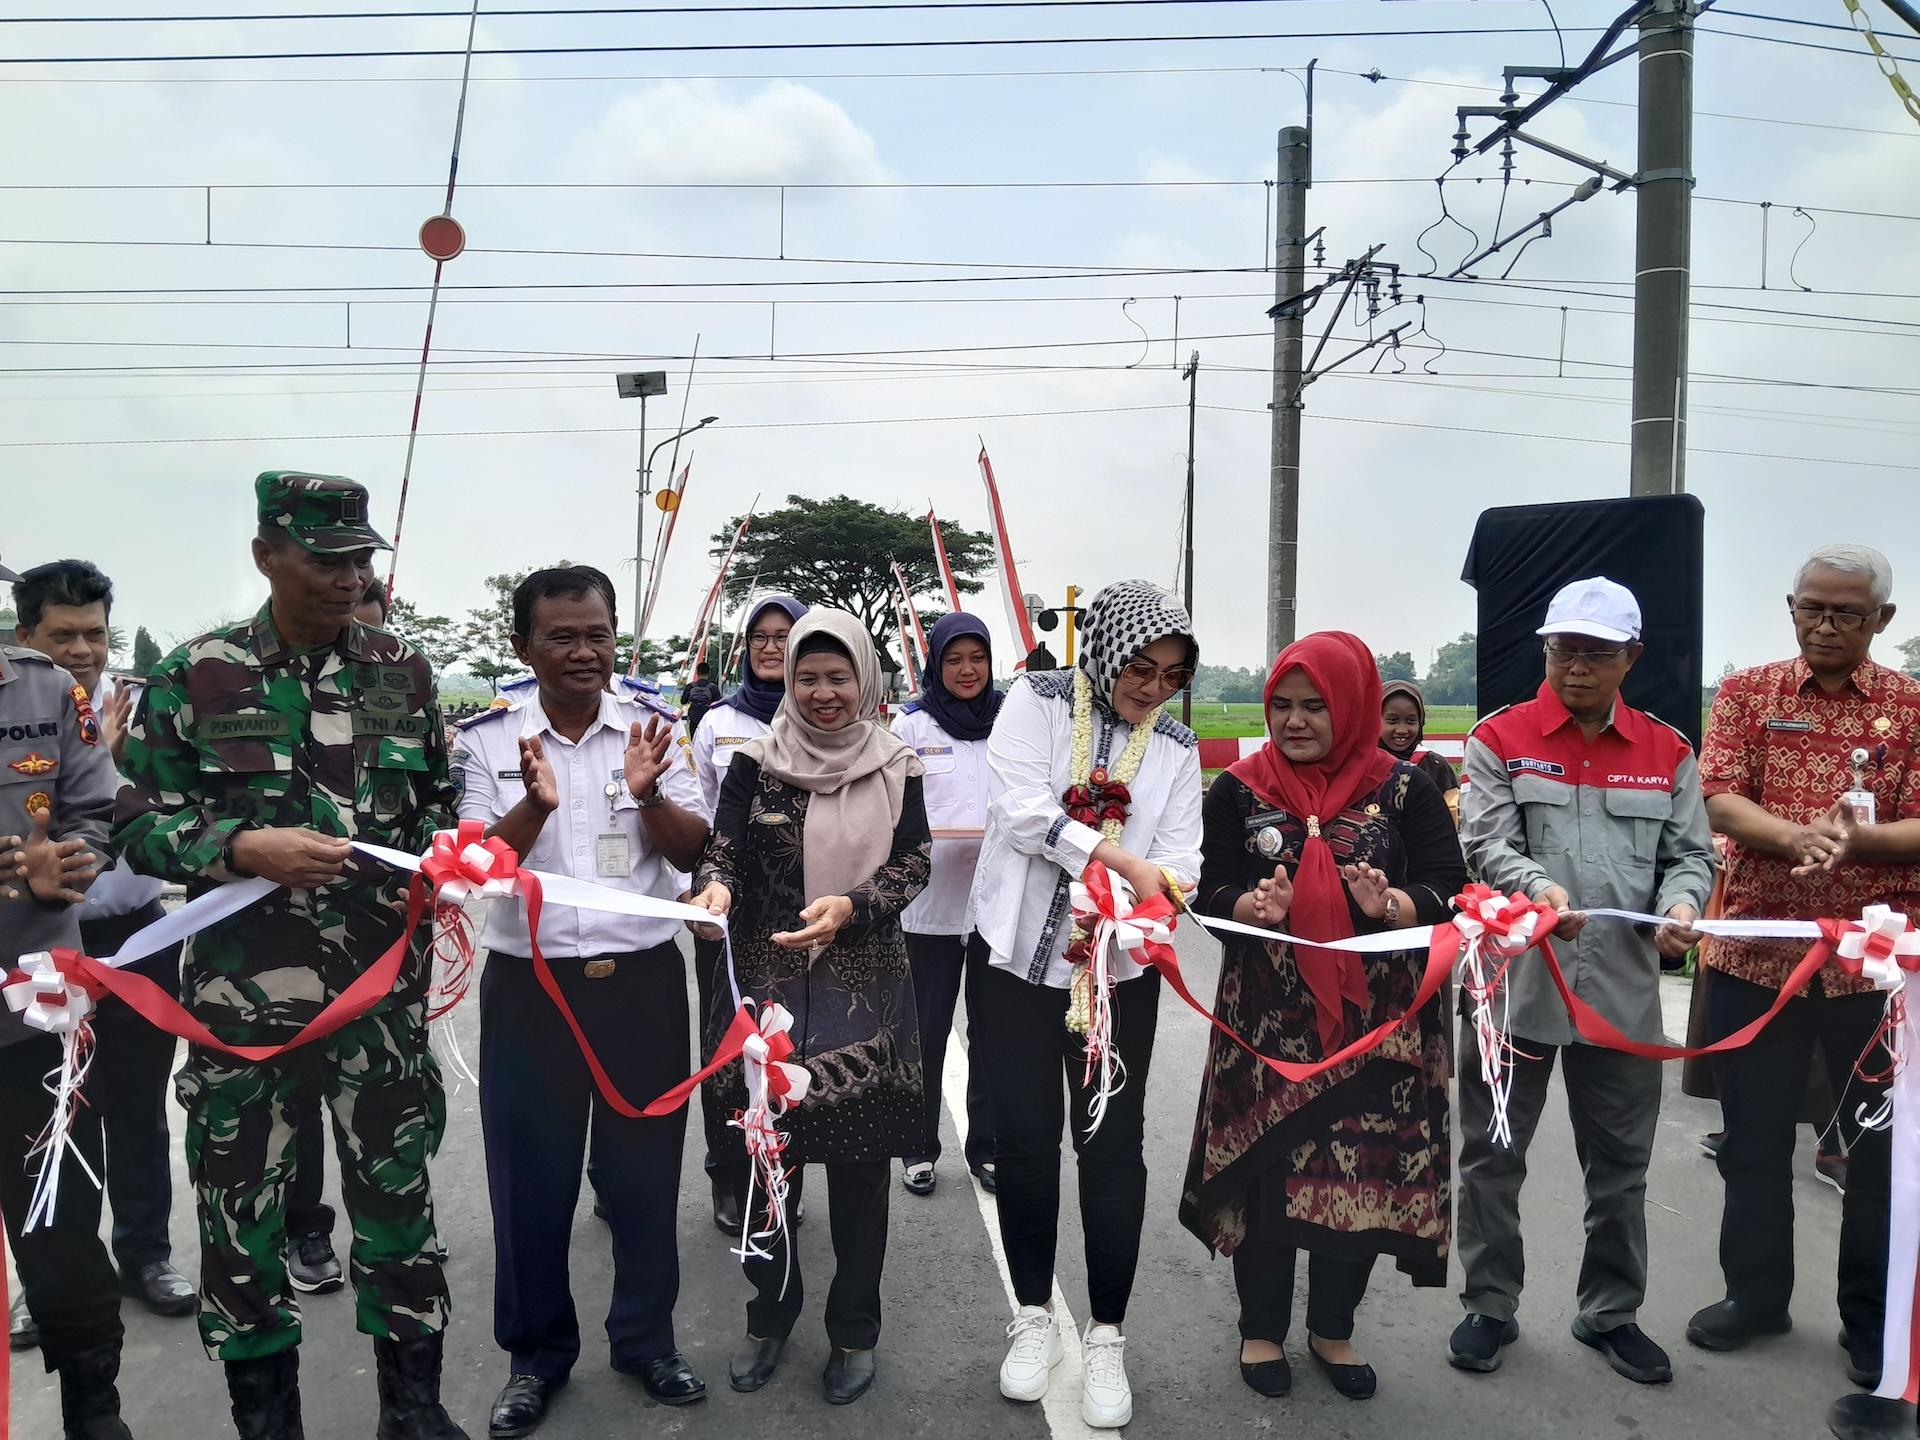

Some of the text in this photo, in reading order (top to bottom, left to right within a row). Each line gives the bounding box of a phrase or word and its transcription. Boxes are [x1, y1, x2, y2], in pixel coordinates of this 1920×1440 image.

[0, 722, 58, 741] POLRI
[210, 719, 280, 734] PURWANTO
[360, 717, 416, 733] TNI AD
[1607, 774, 1670, 786] CIPTA KARYA
